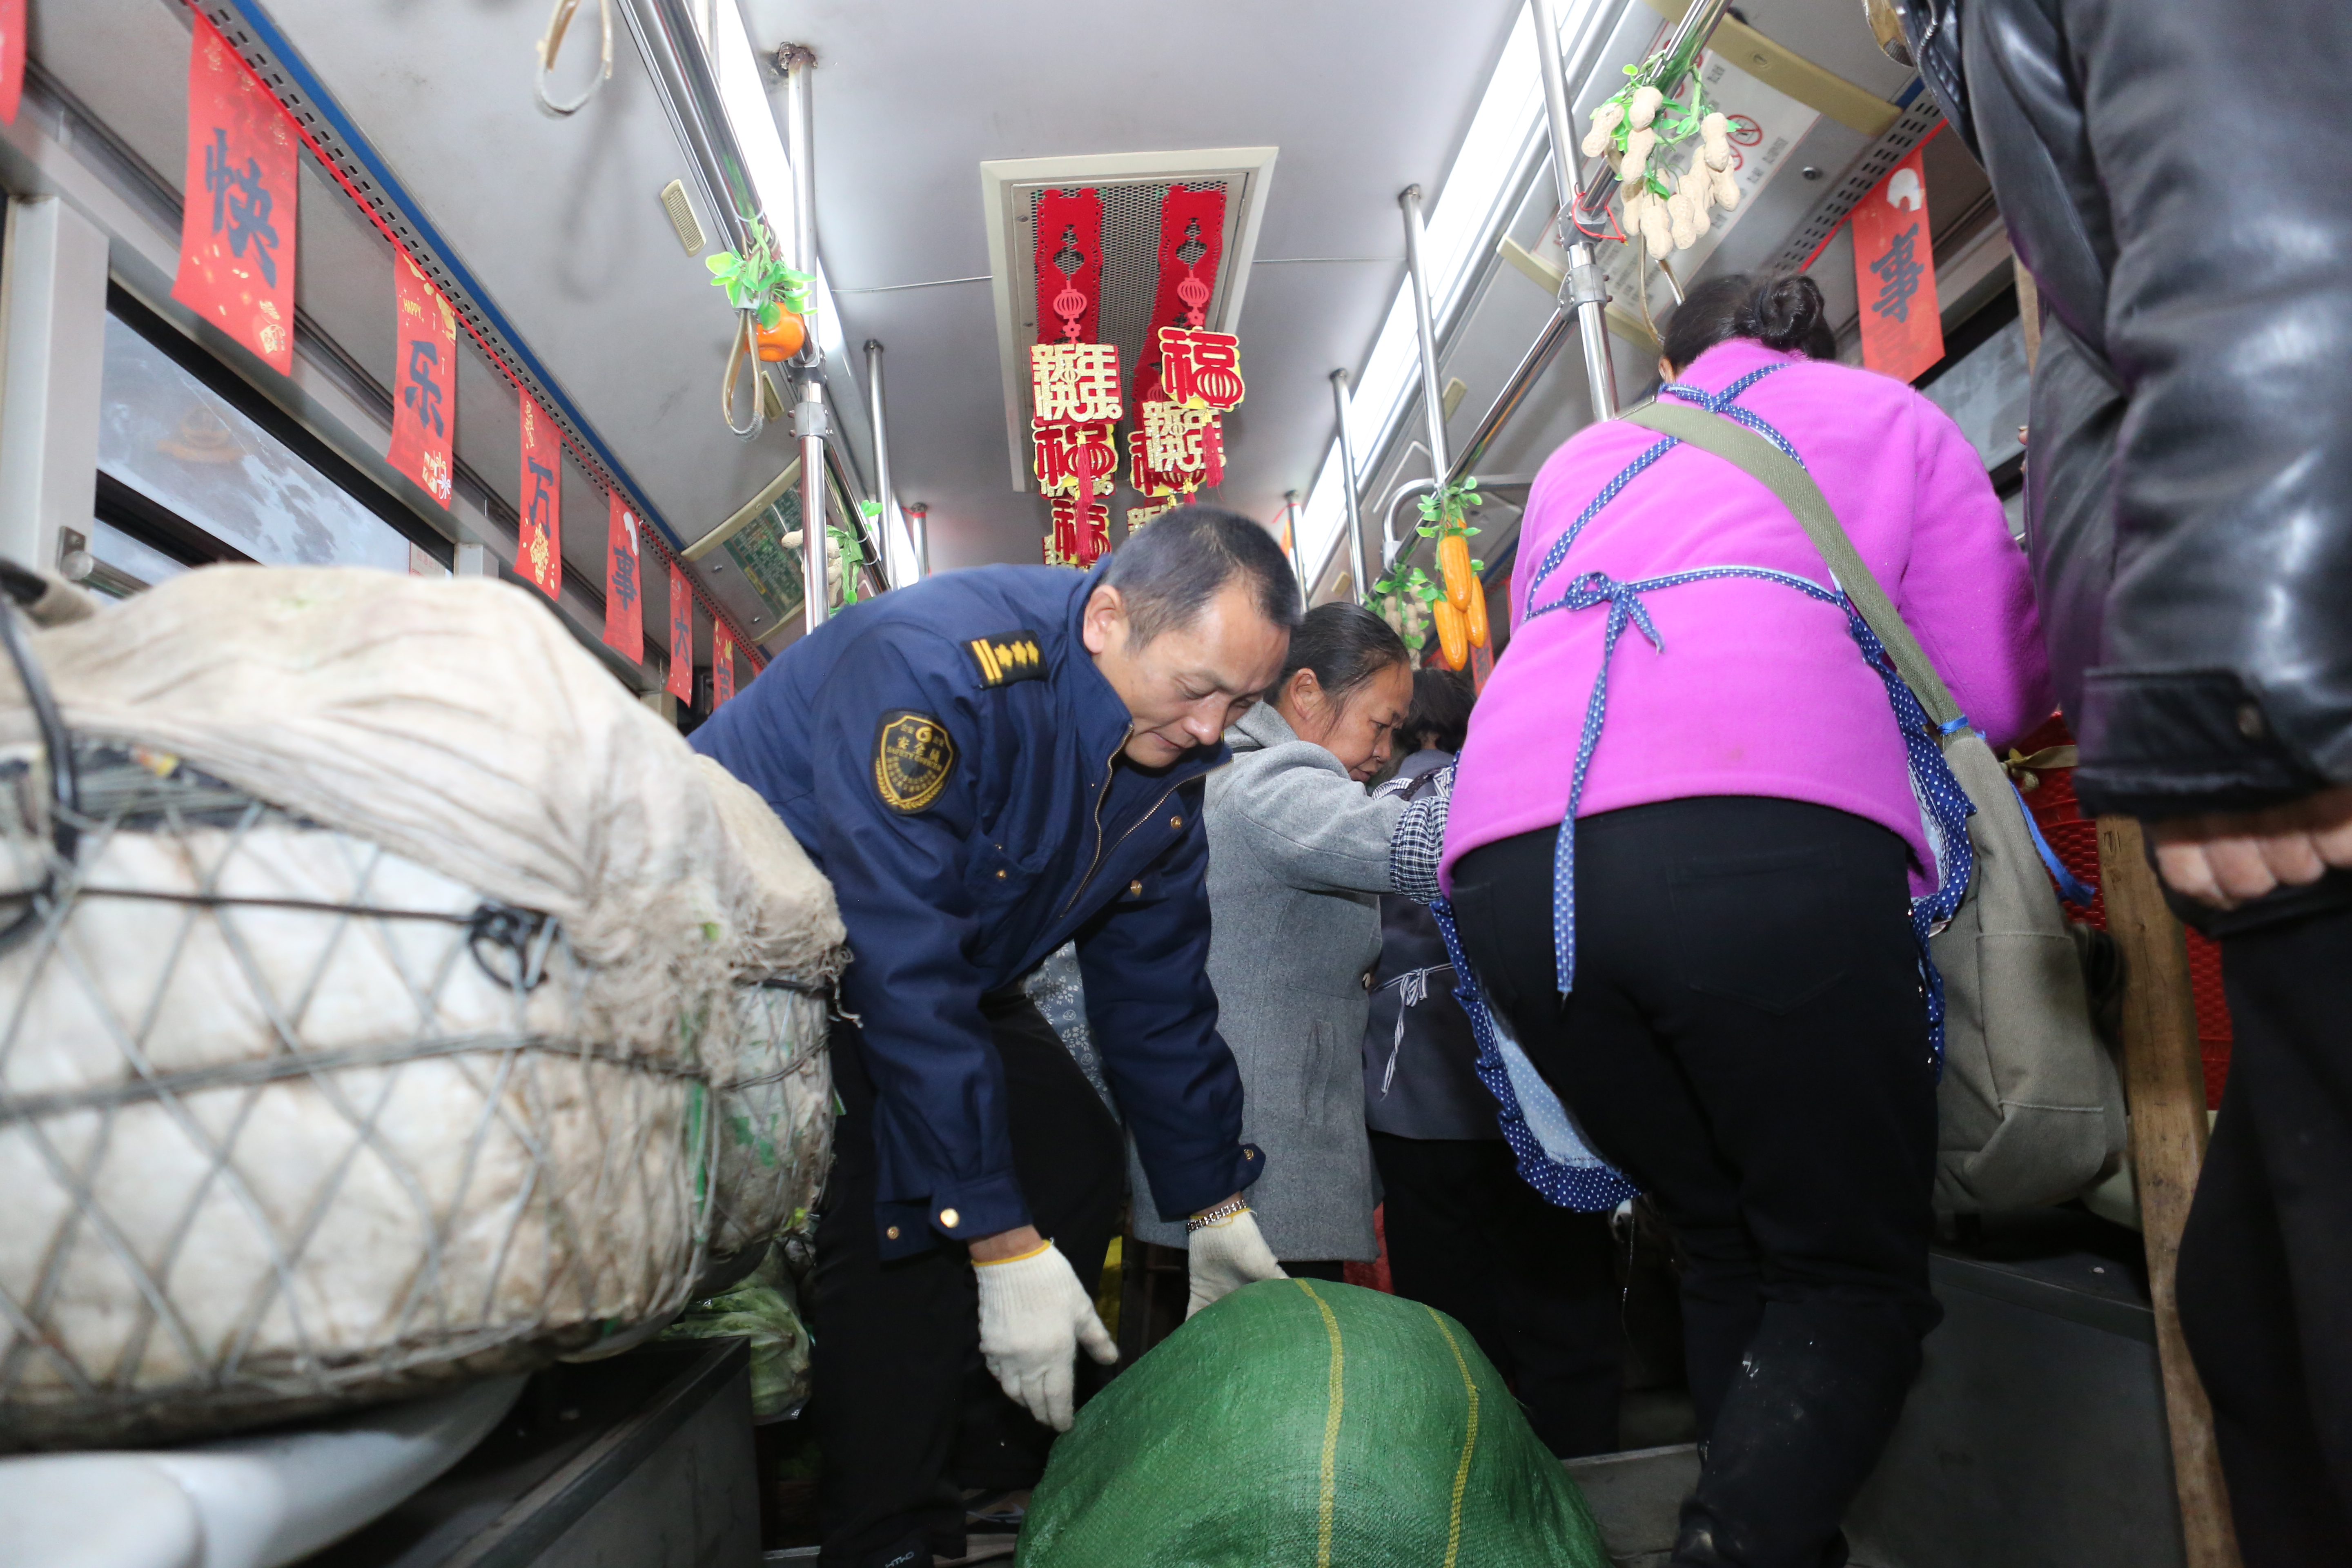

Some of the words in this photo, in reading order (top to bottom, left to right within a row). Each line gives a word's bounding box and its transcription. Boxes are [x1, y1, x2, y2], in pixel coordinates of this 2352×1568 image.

[205, 128, 279, 289] 快
[403, 298, 421, 319] HAPPY
[1869, 223, 1924, 323] 事
[405, 340, 444, 438] 乐
[1159, 327, 1243, 408] 福
[528, 456, 554, 540] 万
[612, 545, 637, 611] 事
[674, 607, 690, 668] 大
